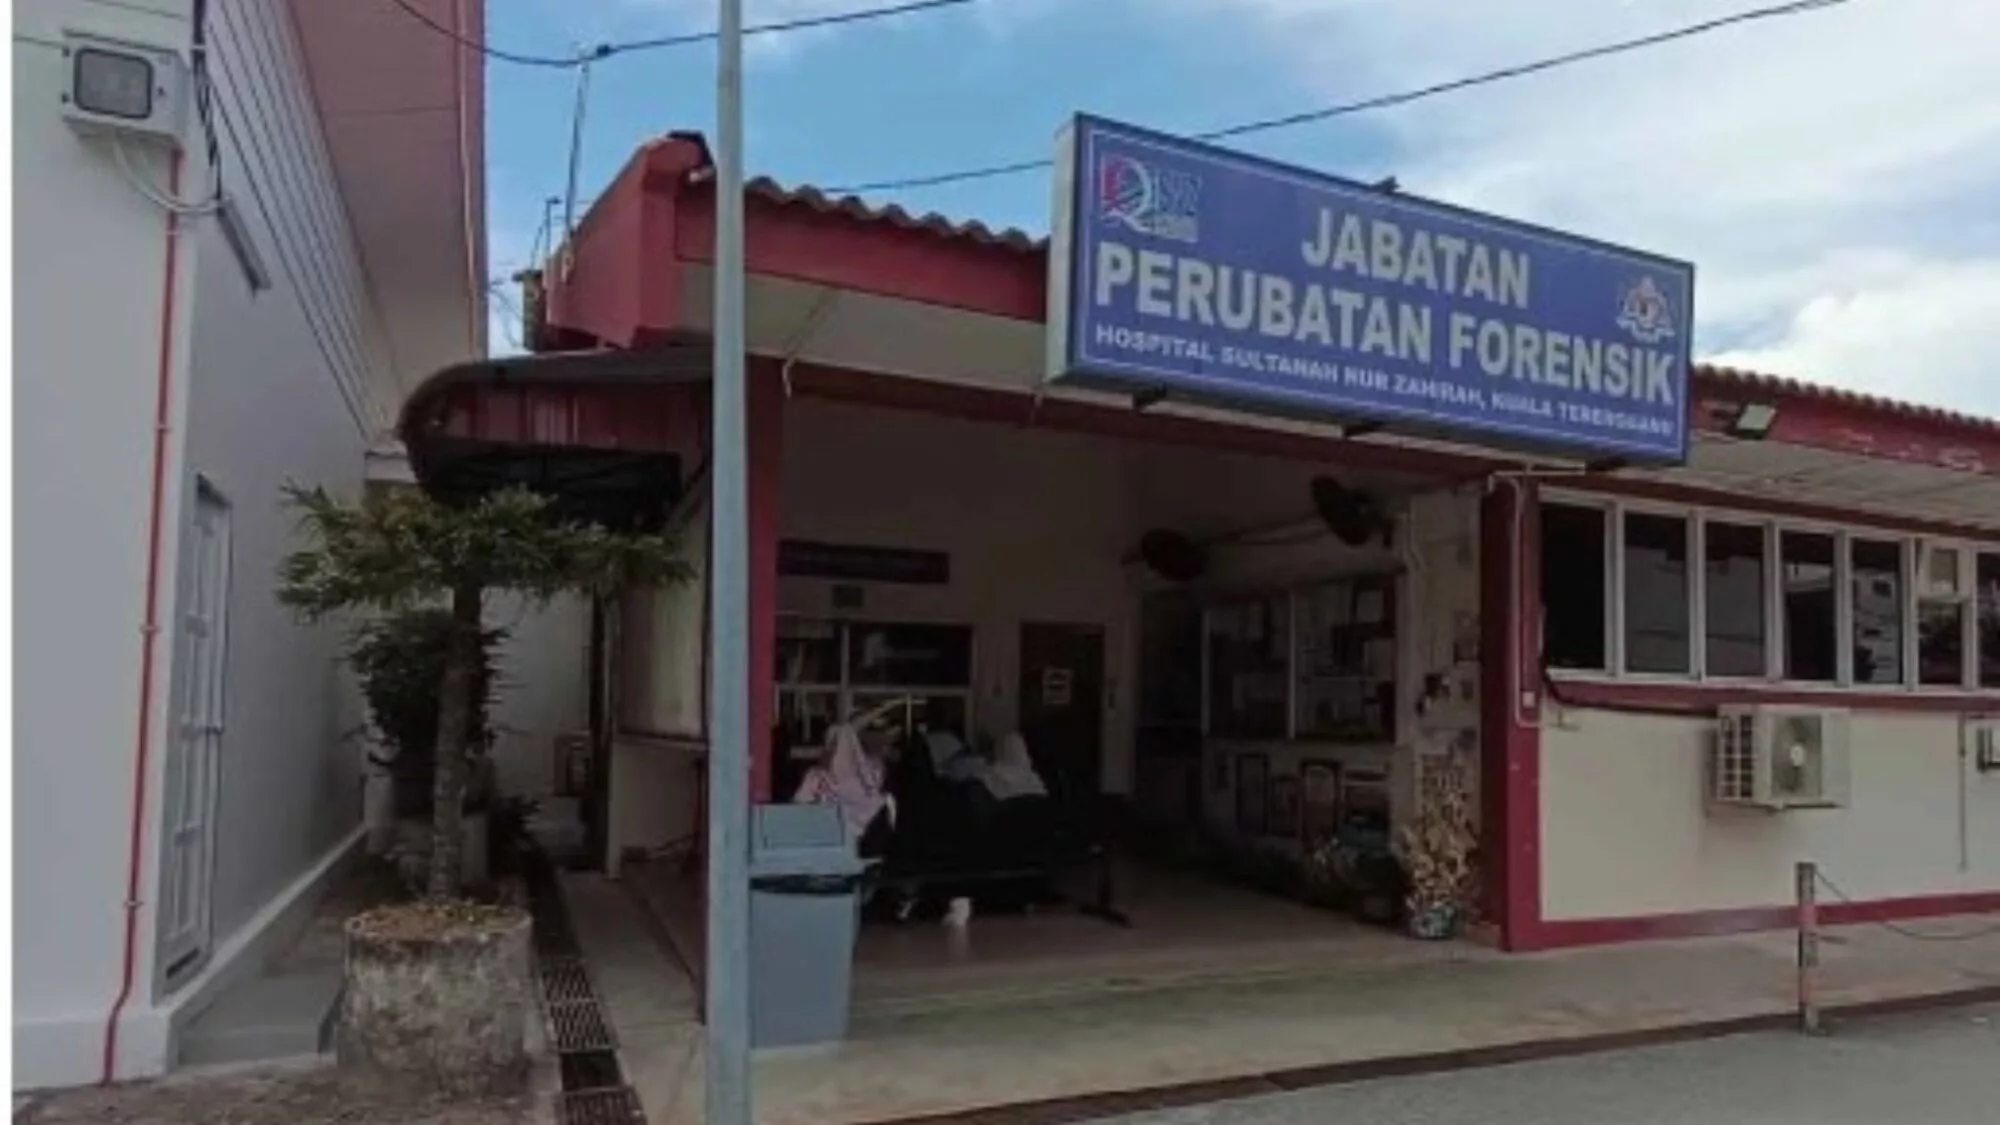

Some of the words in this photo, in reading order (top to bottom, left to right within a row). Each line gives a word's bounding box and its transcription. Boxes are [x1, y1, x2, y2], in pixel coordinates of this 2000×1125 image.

[1302, 207, 1530, 309] JABATAN
[1095, 323, 1214, 363] HOSPITAL
[1220, 346, 1339, 384] SULTANAH
[1344, 367, 1390, 392] NUR
[1096, 241, 1432, 365] PERUBATAN
[1449, 311, 1675, 405] FORENSIK
